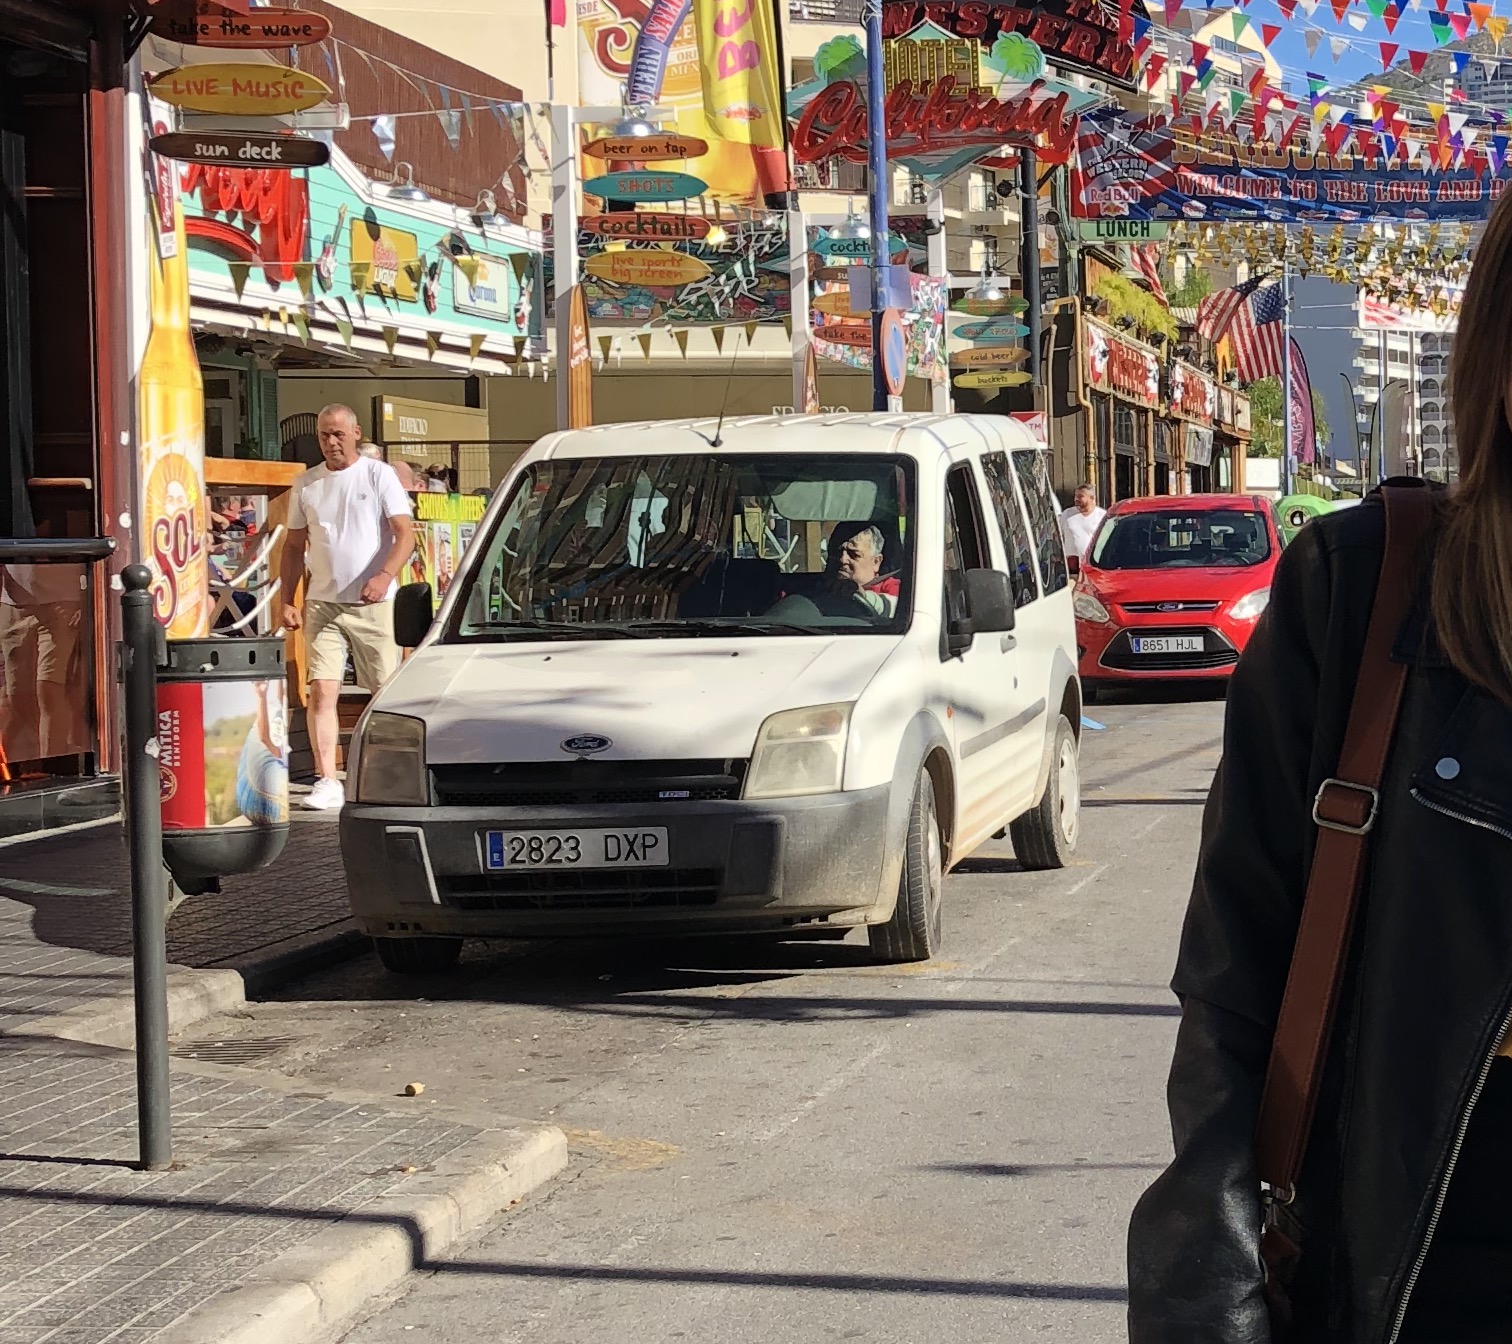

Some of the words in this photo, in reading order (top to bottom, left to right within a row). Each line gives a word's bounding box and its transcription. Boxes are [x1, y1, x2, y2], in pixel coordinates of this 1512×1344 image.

[170, 19, 210, 36] take
[219, 19, 251, 36] the
[262, 24, 312, 36] wave
[172, 78, 219, 96] LIVE
[232, 79, 305, 100] MUSIC
[195, 143, 229, 156] sun
[238, 141, 282, 160] deck
[603, 142, 633, 154] beer
[640, 144, 658, 153] on
[664, 141, 687, 156] tap
[617, 178, 674, 193] SHOTS
[1090, 187, 1111, 202] Red
[1112, 187, 1140, 202] Bull
[1176, 173, 1282, 200] WELCOME
[1289, 179, 1317, 201] TO
[1324, 180, 1368, 202] THE
[1375, 180, 1429, 202] LOVE
[1437, 179, 1482, 202] AND
[599, 214, 696, 236] cocktails
[1096, 221, 1150, 237] LUNCH
[641, 255, 681, 268] sports
[611, 267, 631, 282] big
[640, 269, 682, 279] screen
[417, 492, 449, 520] SHOWS
[459, 494, 487, 520] OFFERS
[153, 505, 201, 628] SOL
[1142, 639, 1171, 652] 8651
[1176, 638, 1198, 651] HJL
[172, 709, 181, 767] BENIDORM
[509, 835, 582, 864] 2823
[604, 833, 658, 862] DXP
